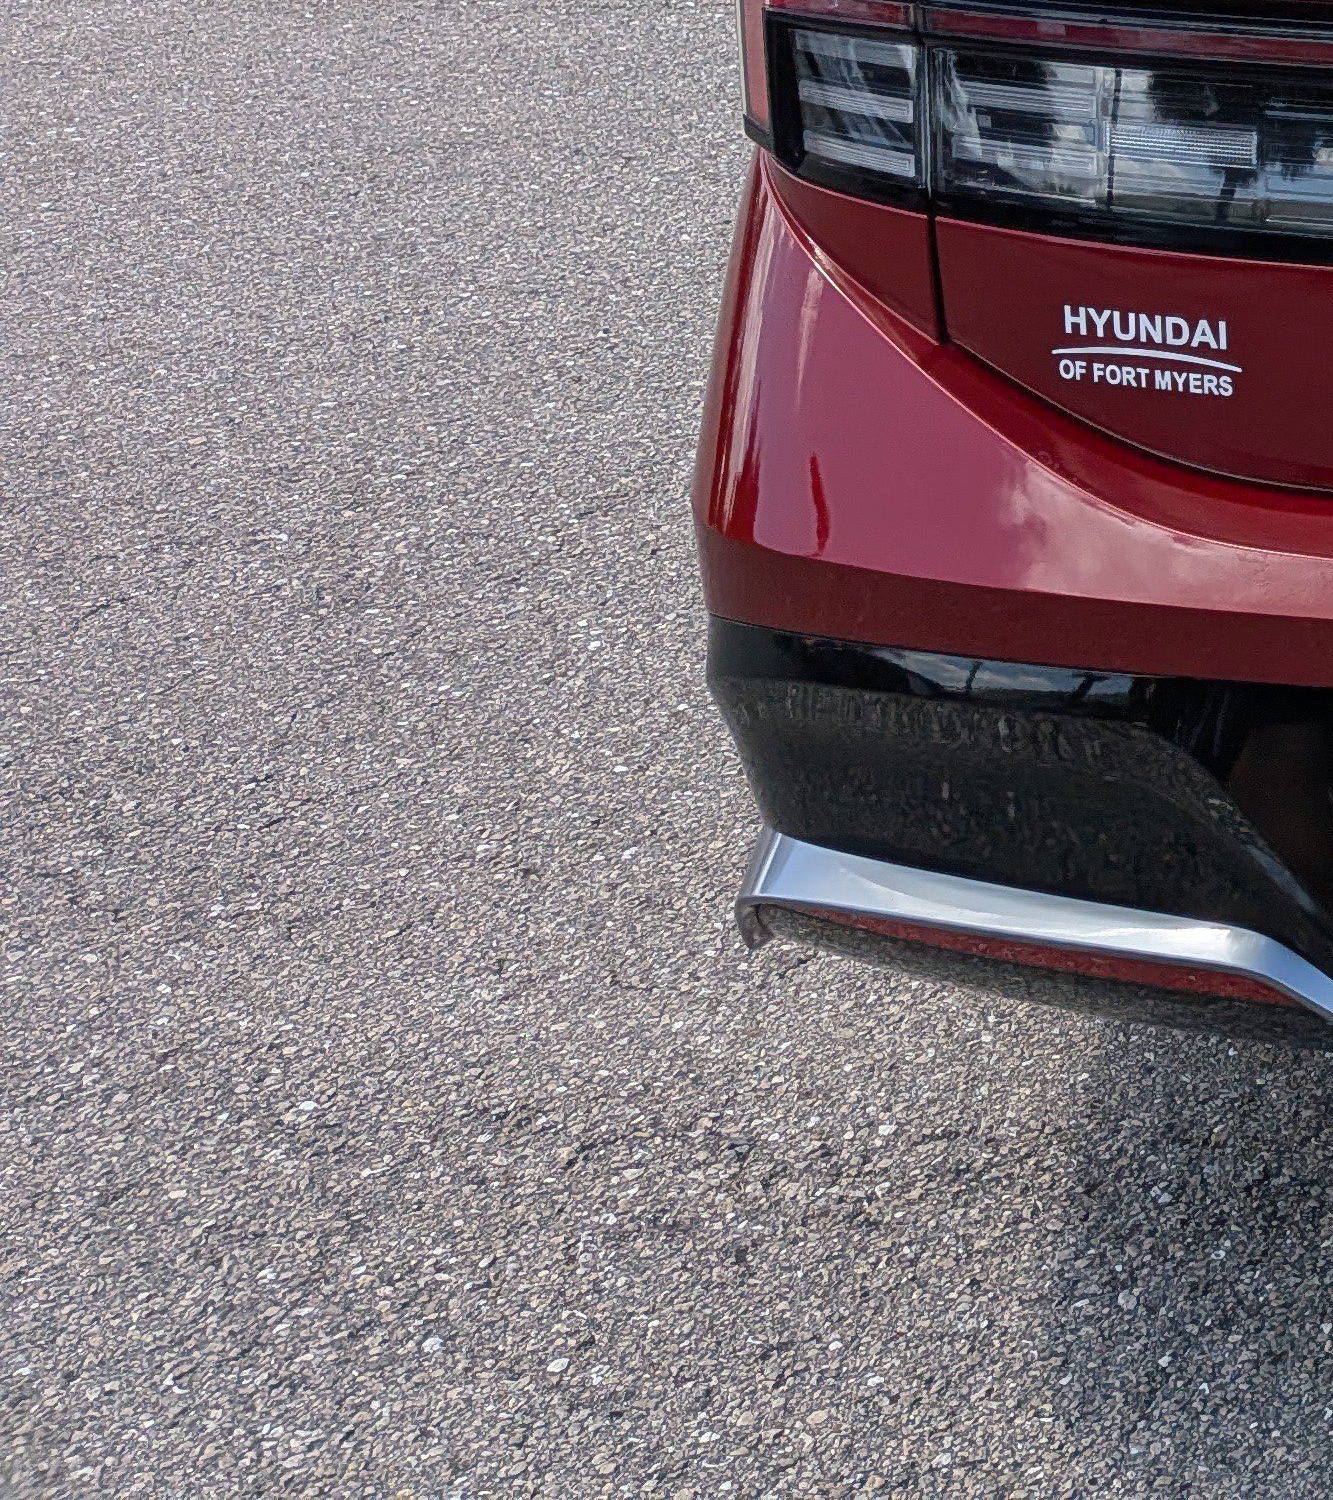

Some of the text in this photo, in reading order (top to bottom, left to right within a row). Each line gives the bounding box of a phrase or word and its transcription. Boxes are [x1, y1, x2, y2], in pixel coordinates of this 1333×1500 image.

[1063, 304, 1228, 351] HYUNDAI
[1058, 358, 1234, 397] OF FORT MYERS
